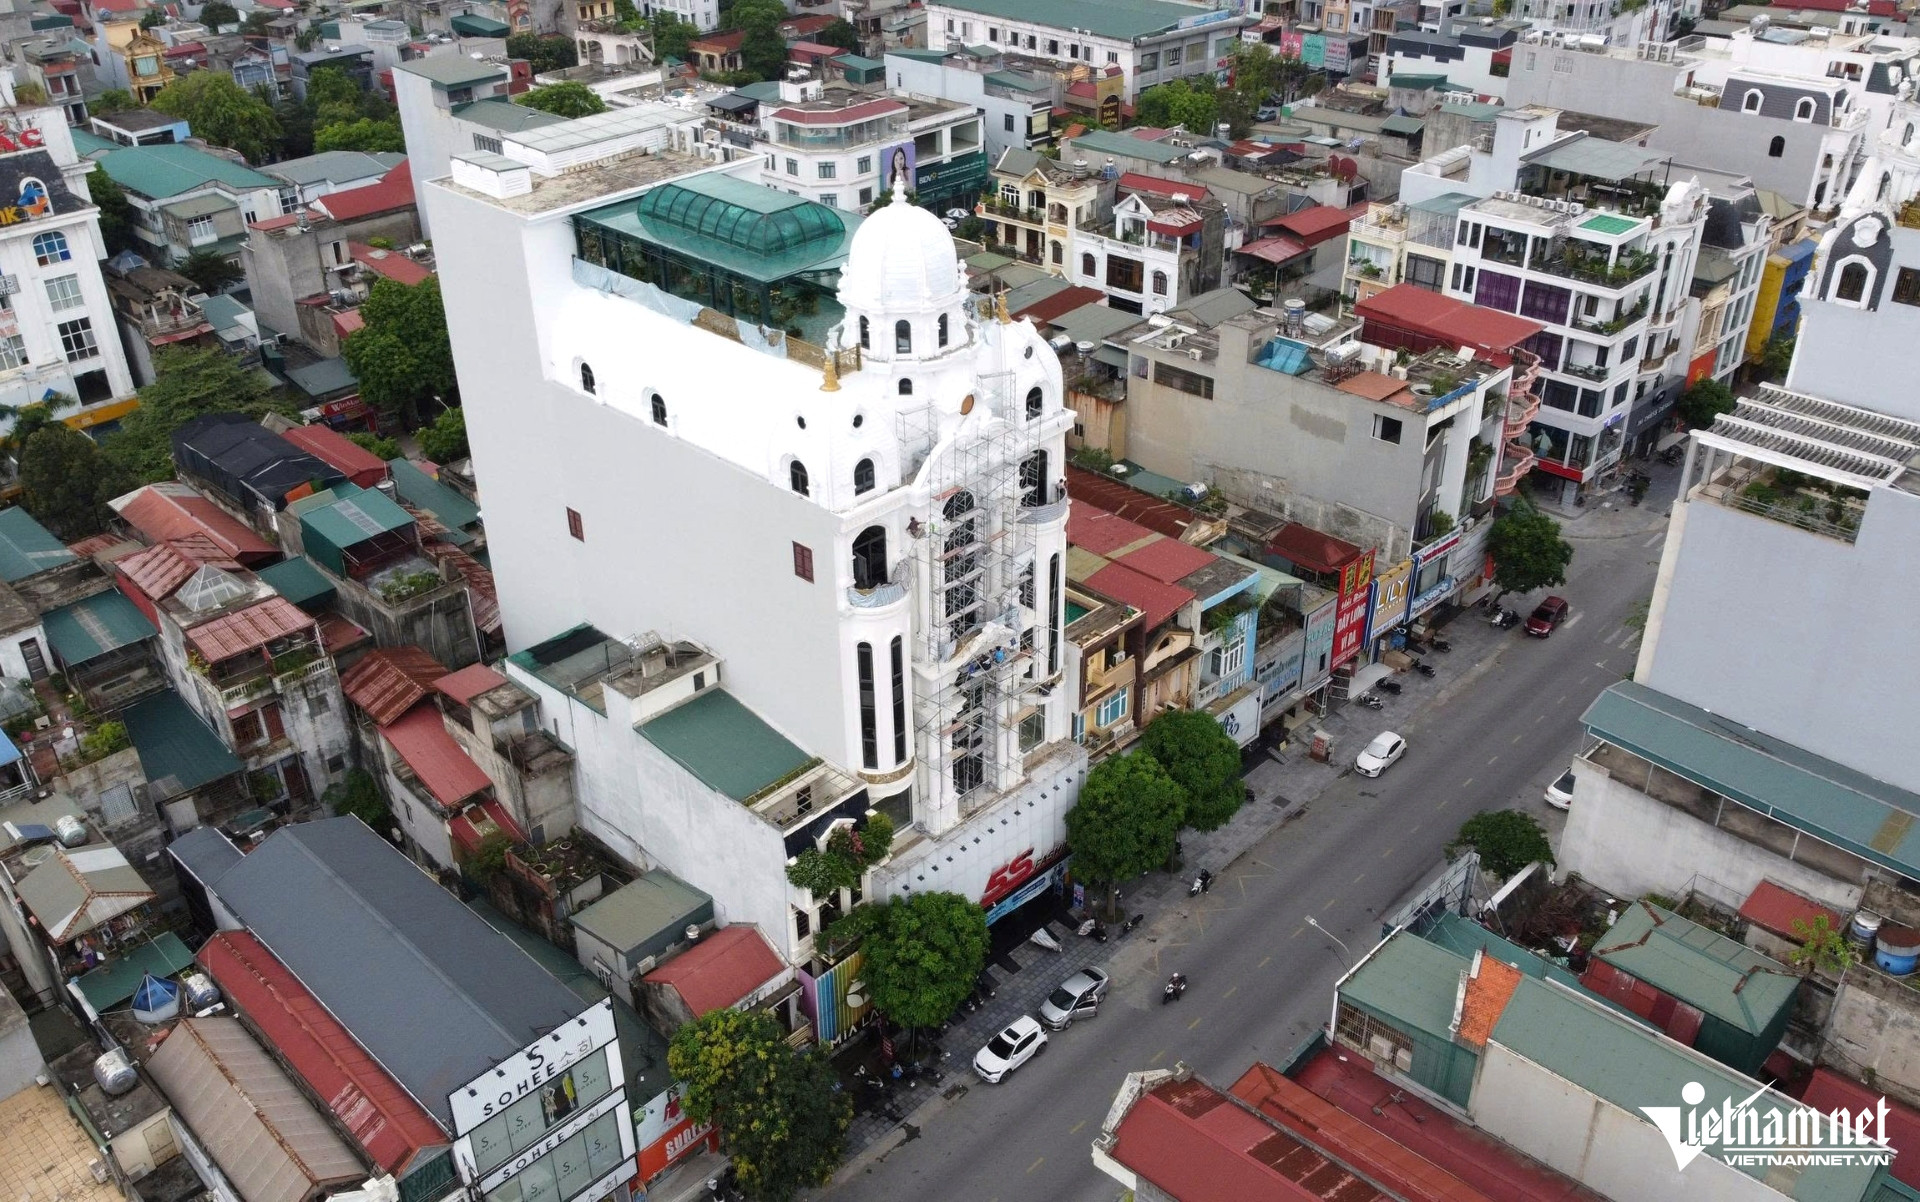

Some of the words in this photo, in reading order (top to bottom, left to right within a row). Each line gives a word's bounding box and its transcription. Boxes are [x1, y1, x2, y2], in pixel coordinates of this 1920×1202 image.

[1377, 573, 1409, 610] LILY
[531, 1046, 545, 1071] S
[560, 1036, 593, 1069] 소희
[483, 1062, 556, 1116] SOHEE
[503, 1133, 564, 1179] SOHEE
